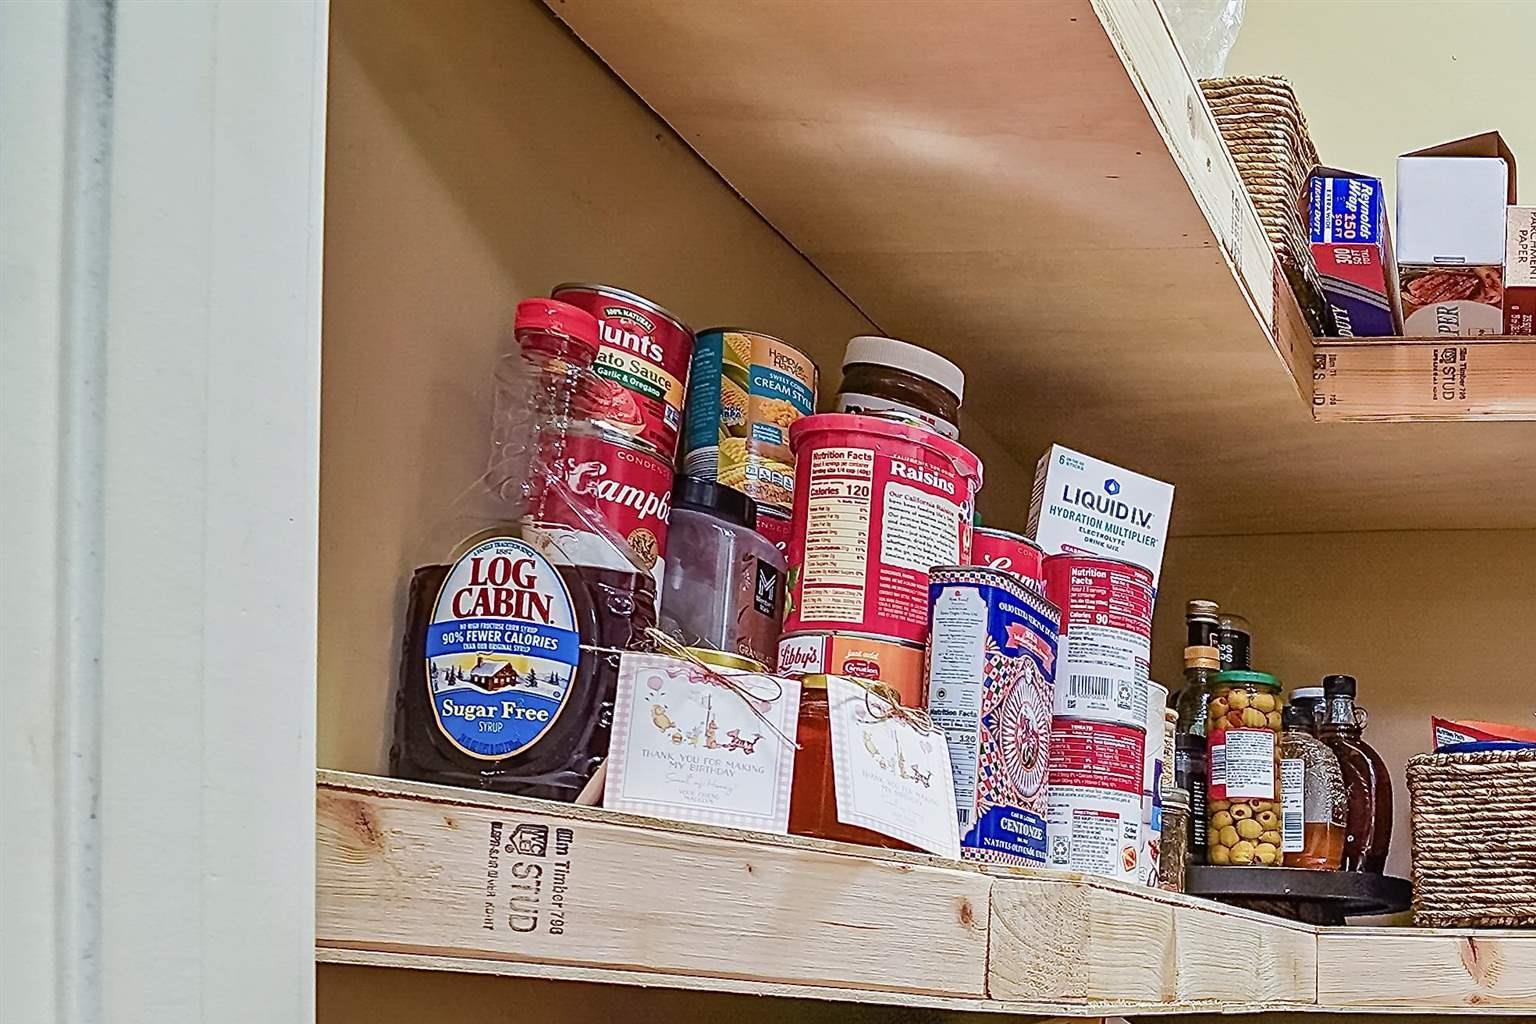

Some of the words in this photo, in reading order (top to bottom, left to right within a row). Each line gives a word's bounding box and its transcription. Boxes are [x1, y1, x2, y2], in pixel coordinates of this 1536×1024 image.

[1345, 180, 1360, 212] Wrap
[1360, 183, 1373, 240] Reynolds
[1344, 213, 1356, 239] 150
[1519, 230, 1528, 263] PAPER
[622, 309, 653, 331] NATURAL
[597, 367, 622, 381] Garlic
[621, 374, 629, 383] &
[630, 376, 661, 397] Oregano
[628, 360, 672, 391] Sauce
[754, 377, 791, 398] CREAM
[1443, 366, 1456, 400] STUD
[812, 451, 844, 461] Nutrition
[847, 450, 873, 462] Facts
[1059, 455, 1065, 465] 6
[890, 460, 955, 495] Raisins
[811, 487, 839, 496] Calories
[846, 485, 869, 497] 120
[1062, 484, 1129, 520] LIQUID
[1049, 504, 1103, 530] HYDRATION
[1104, 522, 1158, 548] MULTIPLIER
[1078, 526, 1125, 546] ELECTROLYTE
[468, 557, 537, 589] LOG
[1071, 567, 1107, 578] Nutrition
[1071, 576, 1093, 585] Facts
[452, 588, 554, 624] CABIN
[1095, 614, 1109, 625] 90
[443, 633, 464, 645] 90%
[467, 631, 501, 643] FEWER
[505, 632, 558, 651] CALORIES
[780, 642, 818, 673] Libby's
[442, 699, 498, 720] Sugar
[501, 700, 549, 721] Free
[478, 721, 503, 733] SYRUP
[642, 750, 673, 763] THANK
[679, 753, 700, 765] YOU
[703, 756, 722, 767] FOR
[725, 759, 766, 775] MAKING
[690, 763, 737, 778] BIRTHDAY
[508, 862, 543, 932] STUD
[551, 861, 570, 908] Timber
